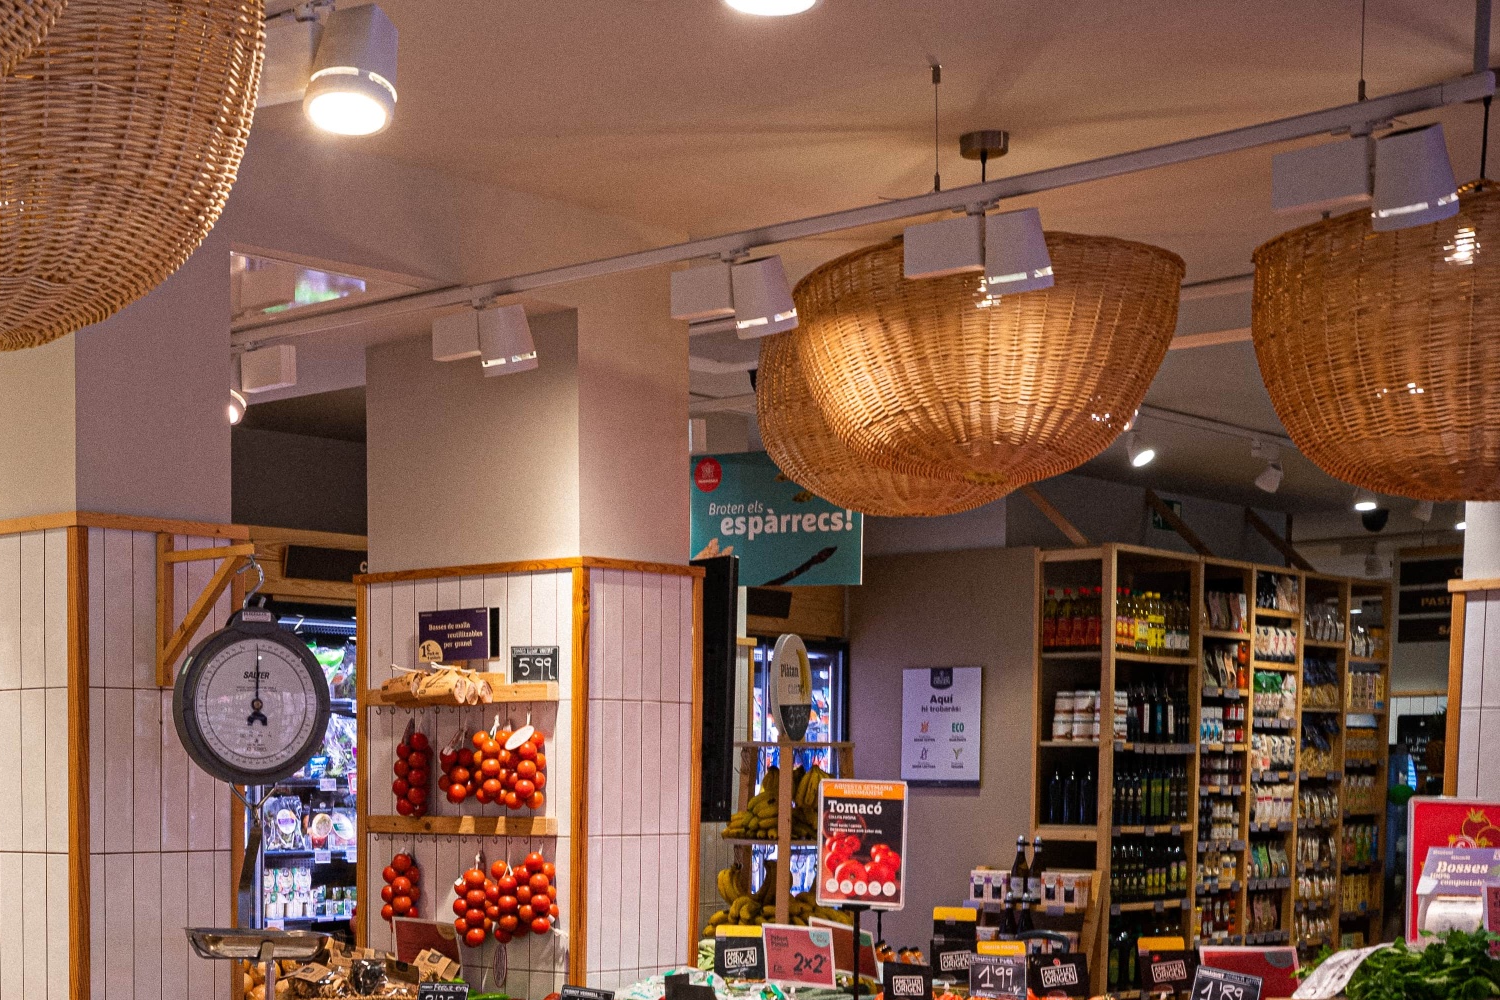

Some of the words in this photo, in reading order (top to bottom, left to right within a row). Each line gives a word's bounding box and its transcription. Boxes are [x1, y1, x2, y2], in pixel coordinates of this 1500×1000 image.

[708, 502, 745, 516] Broten
[747, 500, 764, 513] els
[720, 508, 854, 541] espàrrecs!
[930, 694, 953, 705] Aquí
[921, 705, 929, 713] hi
[951, 722, 965, 733] ECO
[827, 800, 883, 815] Tomacó
[1436, 861, 1489, 874] Bosses
[895, 985, 923, 994] ORIGEN
